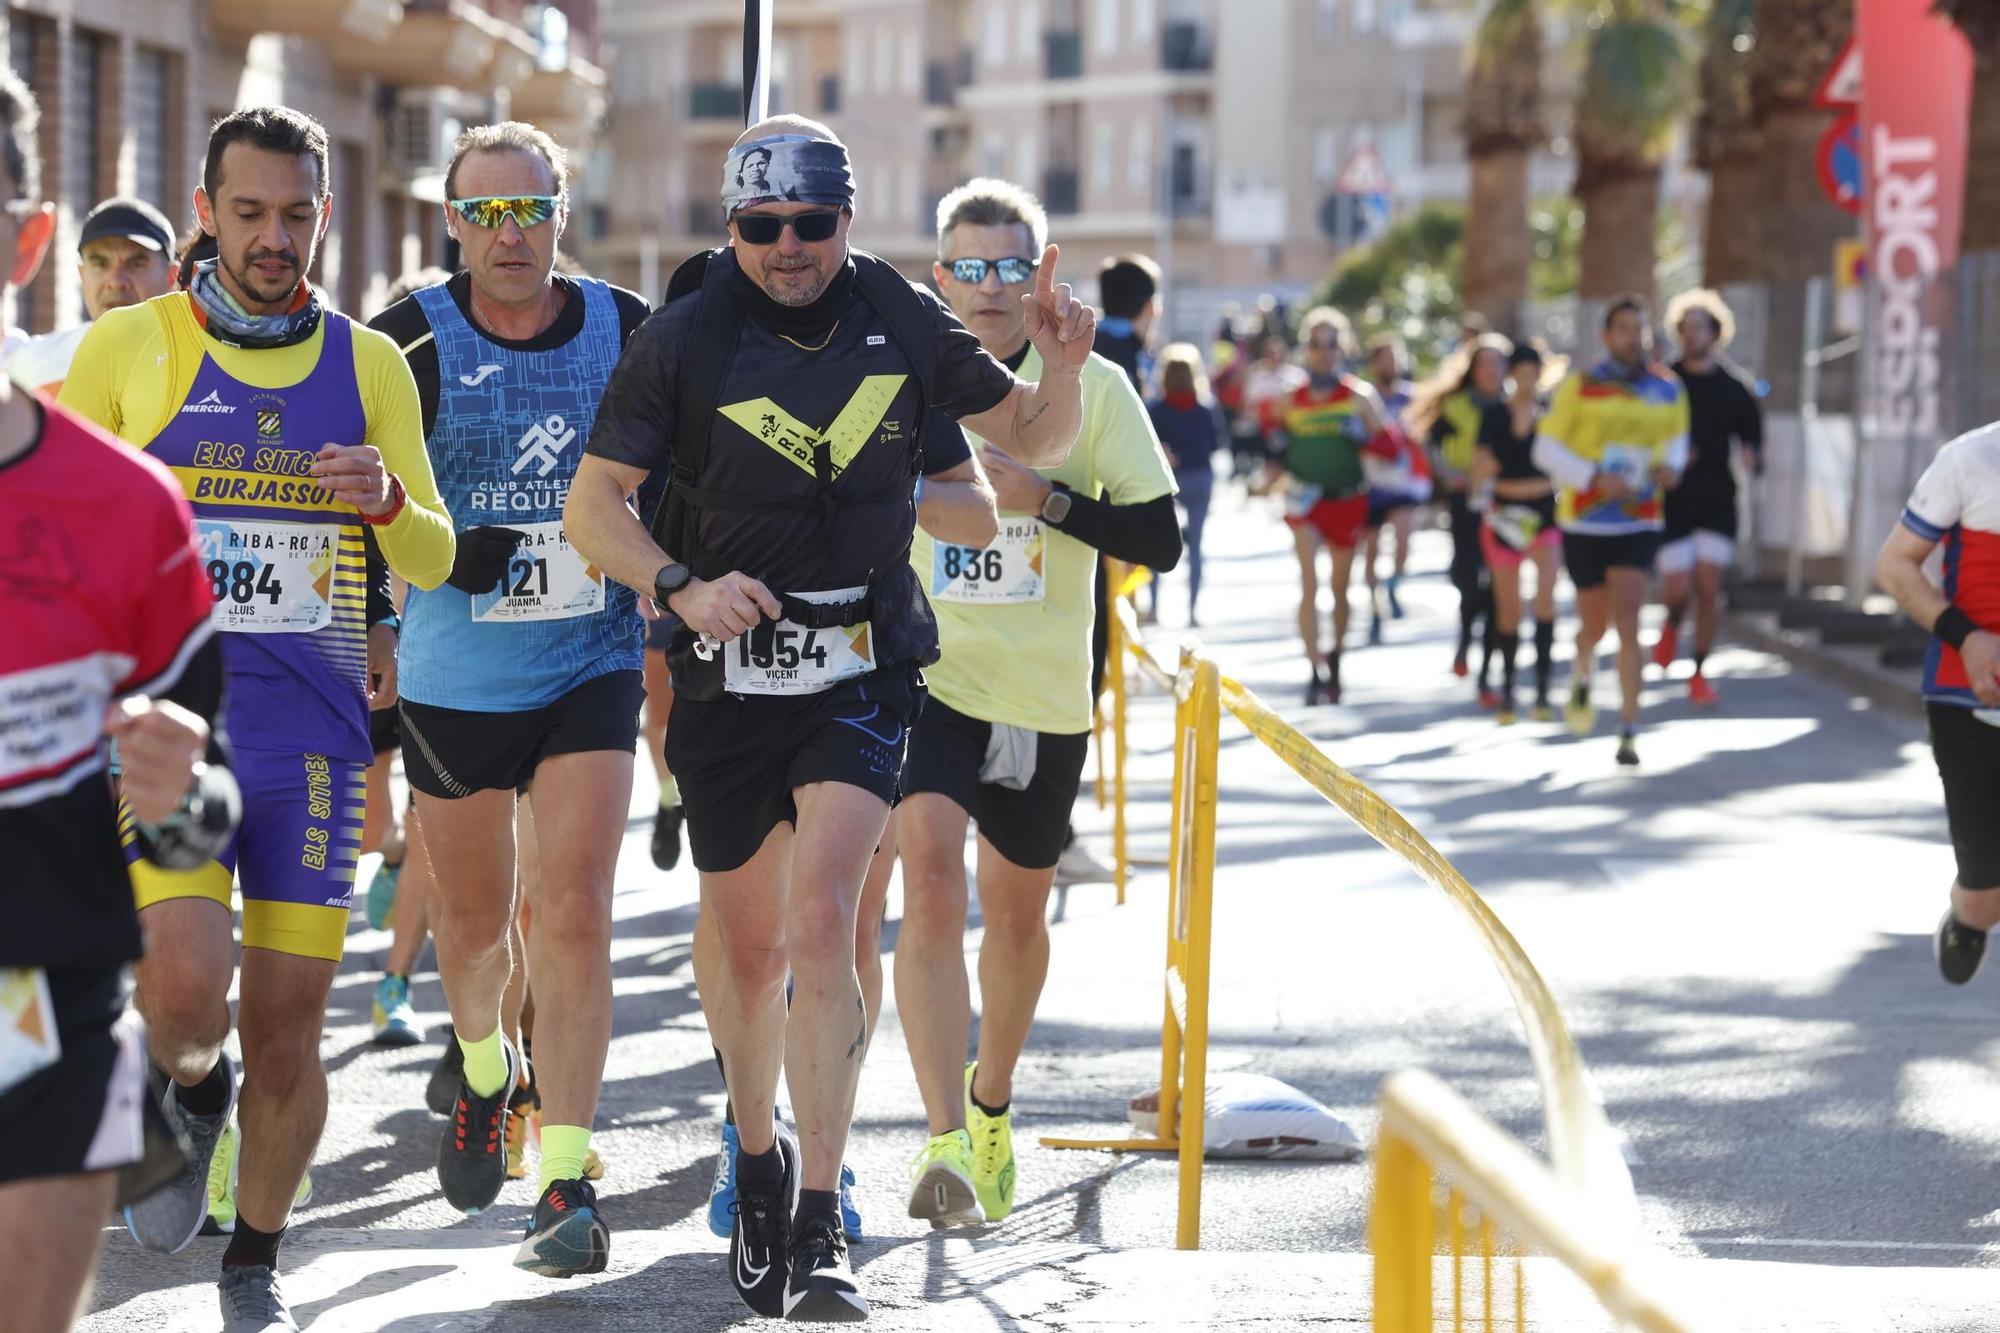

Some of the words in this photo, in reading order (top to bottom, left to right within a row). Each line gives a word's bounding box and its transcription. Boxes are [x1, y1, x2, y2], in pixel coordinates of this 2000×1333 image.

[181, 404, 237, 414] MERCURY
[193, 440, 245, 470] ELS
[479, 481, 517, 491] CLUB
[525, 479, 570, 490] ATLET
[471, 490, 568, 511] REQUE
[229, 532, 330, 550] RIBA-ROA
[944, 546, 1002, 582] 836
[206, 559, 282, 605] 884
[506, 597, 542, 608] JUANMA
[302, 827, 328, 870] ELS
